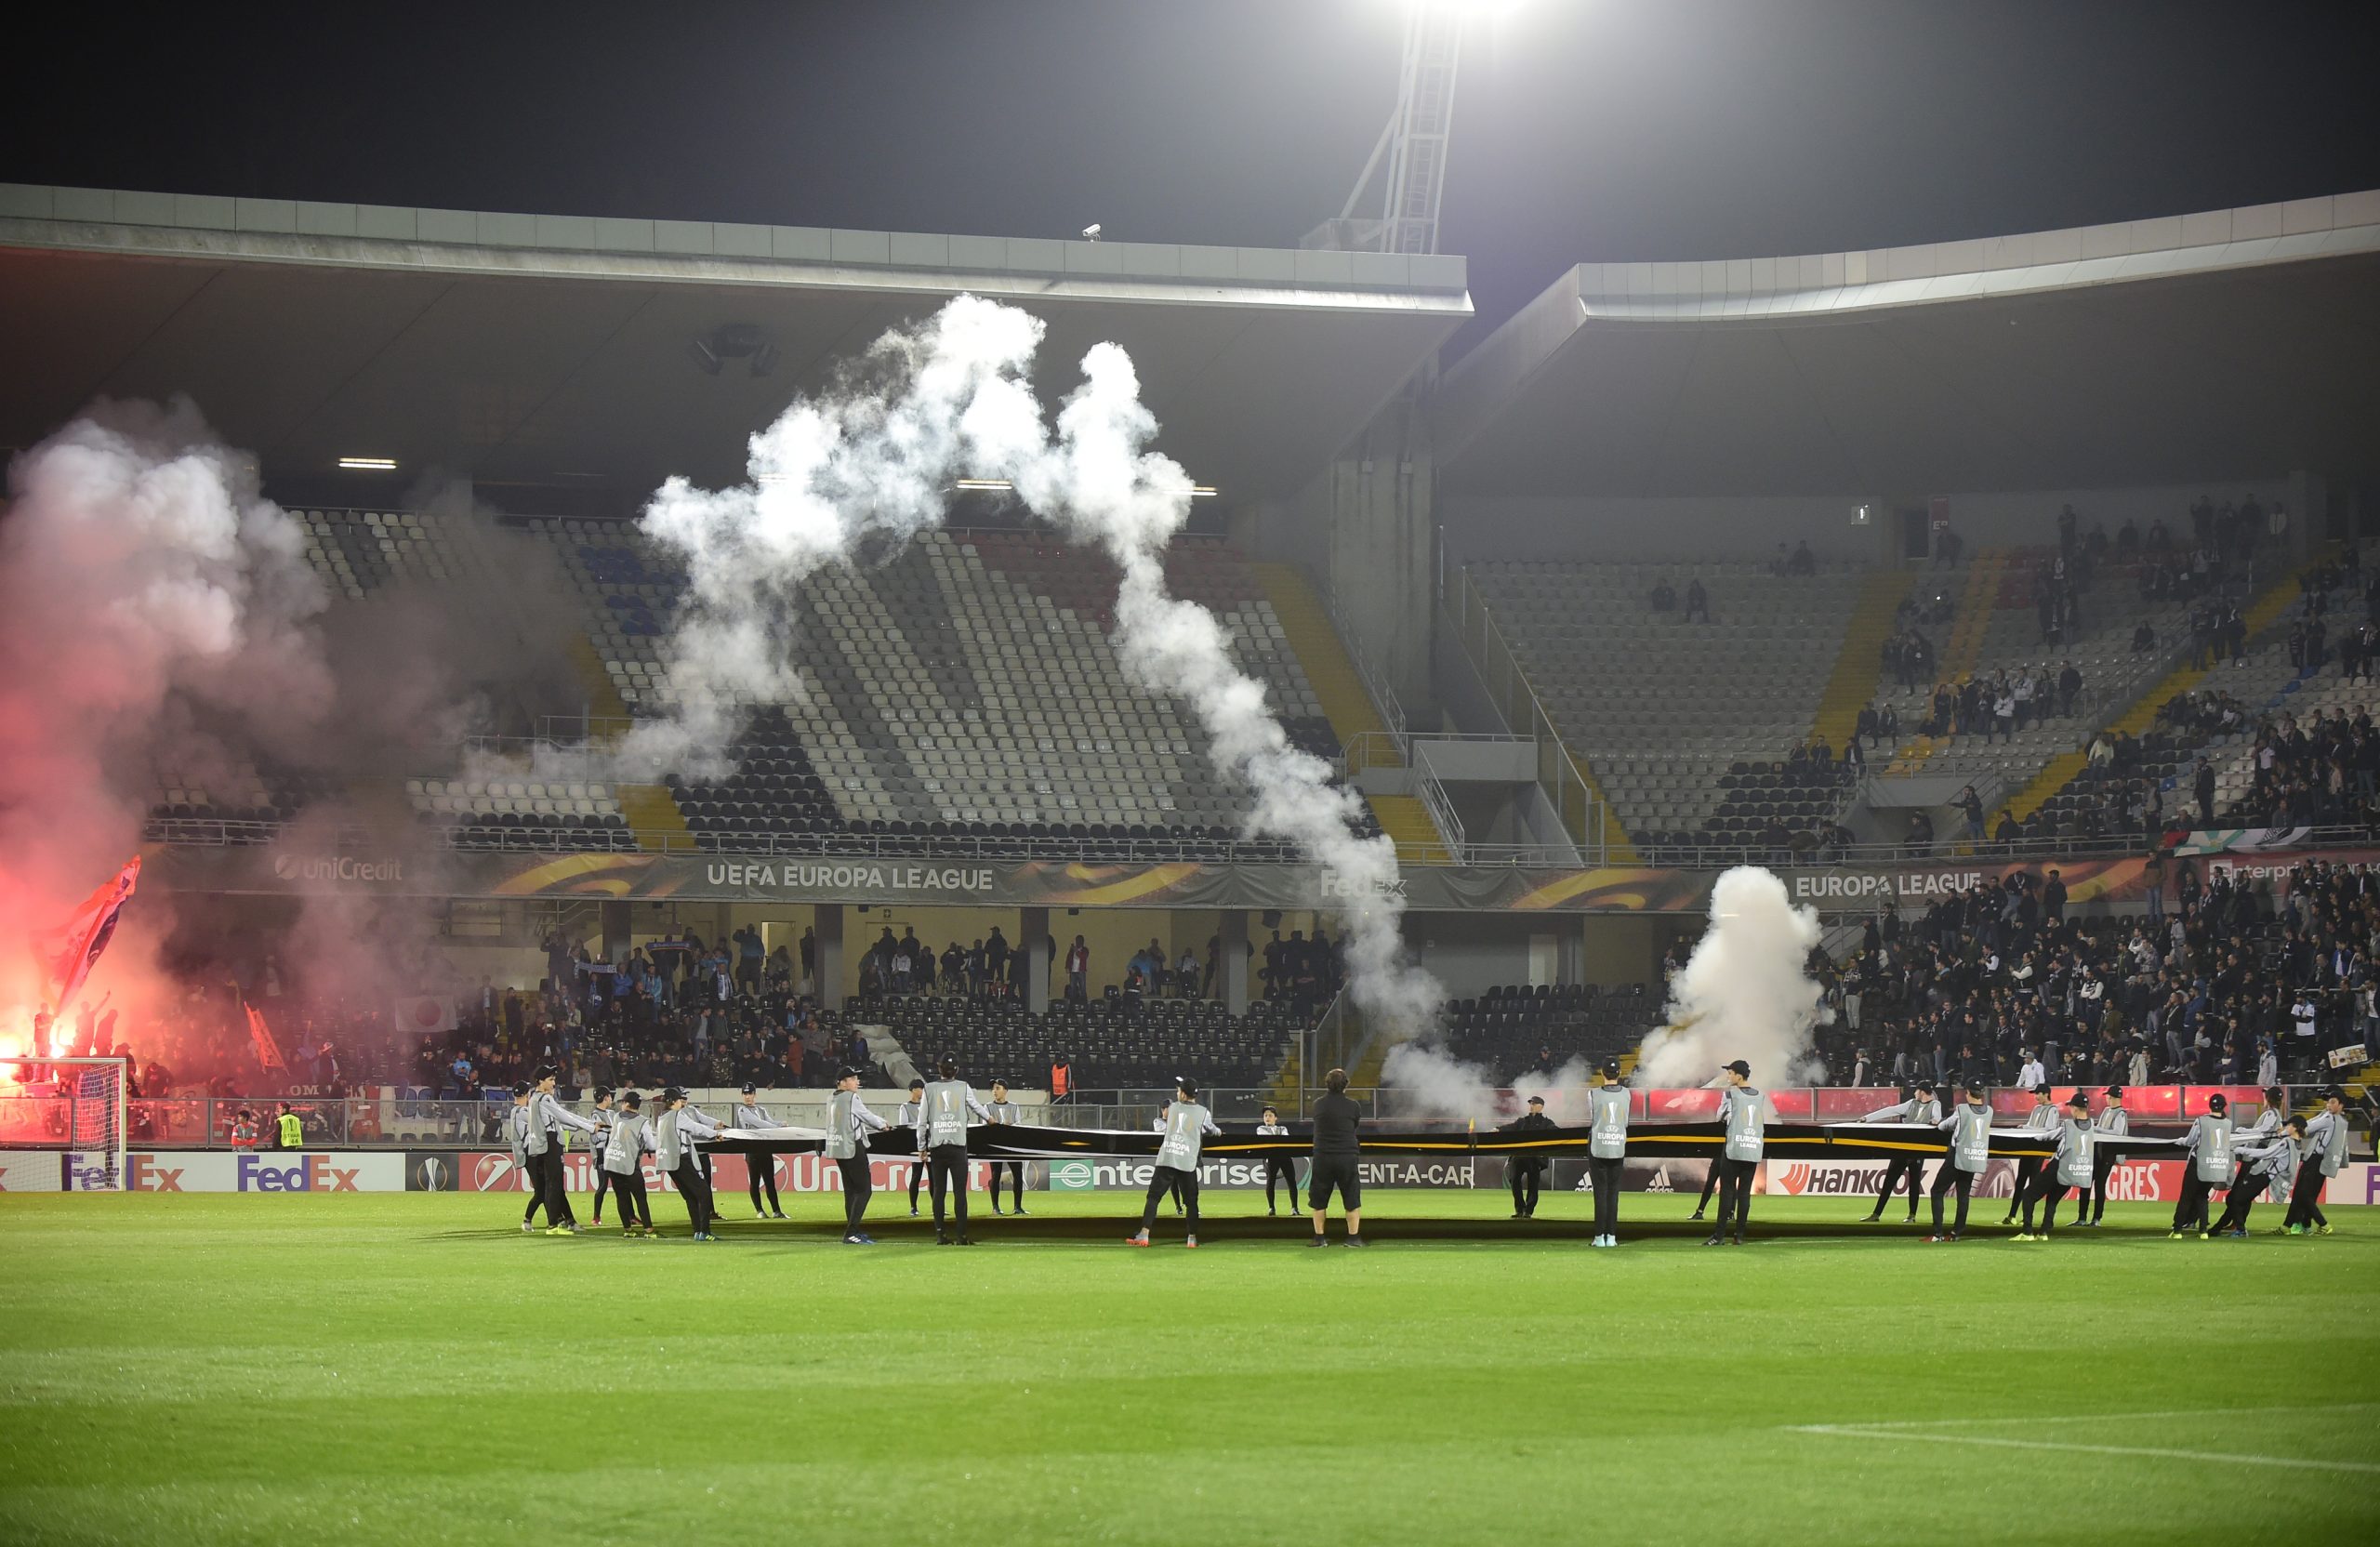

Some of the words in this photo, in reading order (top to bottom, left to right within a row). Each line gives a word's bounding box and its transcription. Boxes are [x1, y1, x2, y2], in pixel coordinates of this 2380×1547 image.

[707, 864, 777, 886] UEFA
[784, 866, 885, 888] EUROPA
[892, 866, 993, 891] LEAGUE
[1796, 875, 1893, 897] EUROPA
[1898, 872, 1981, 895] LEAGUE
[1597, 1132, 1625, 1142] EUROPA
[1736, 1134, 1762, 1144] EUROPA
[238, 1155, 361, 1191] FedEx
[1357, 1163, 1475, 1186] ENT-A-CAR
